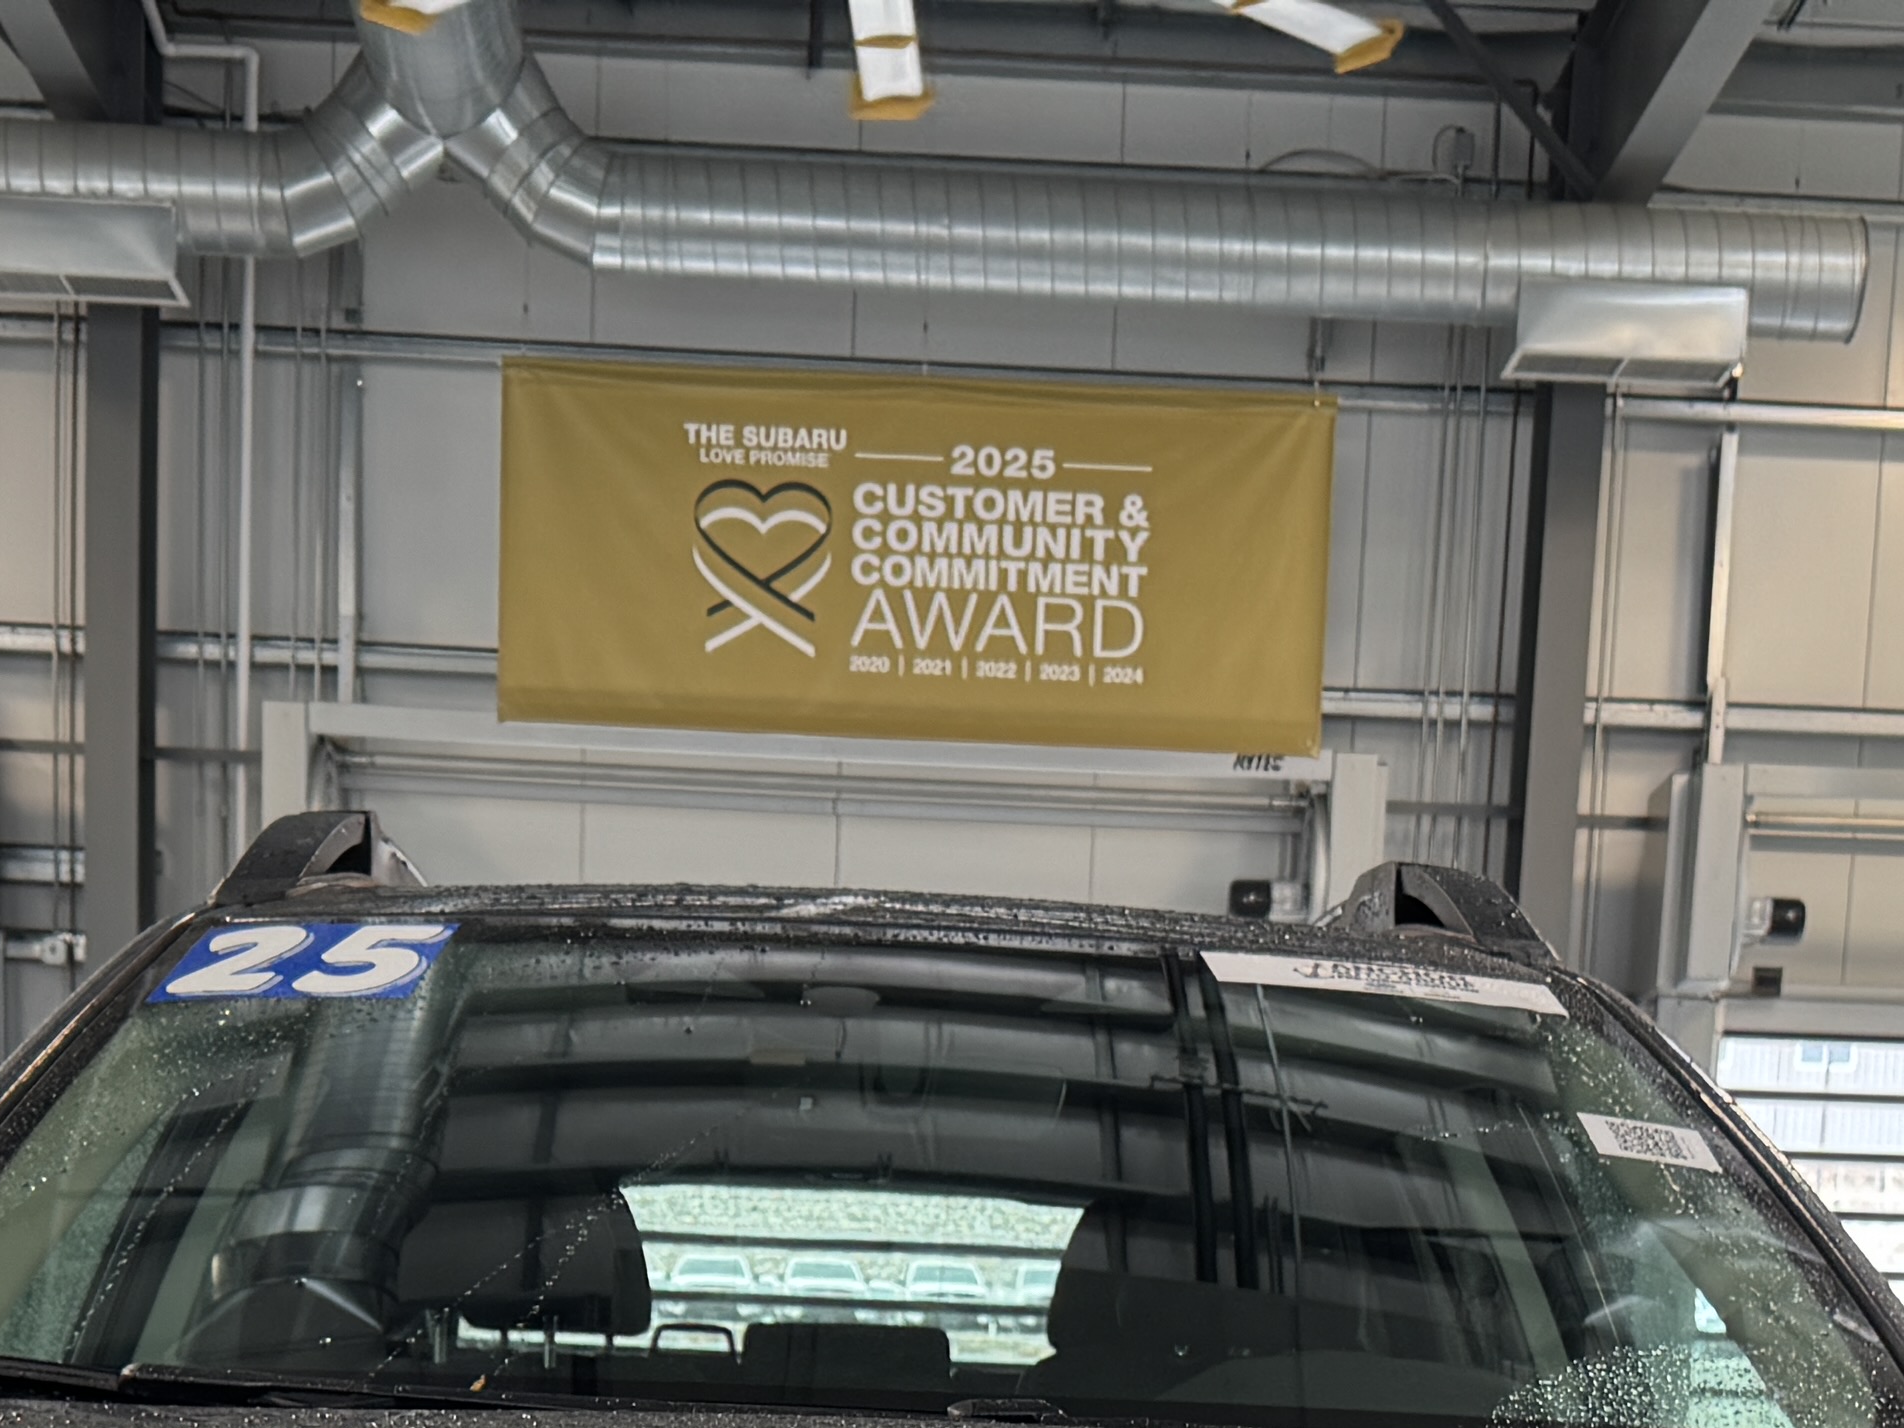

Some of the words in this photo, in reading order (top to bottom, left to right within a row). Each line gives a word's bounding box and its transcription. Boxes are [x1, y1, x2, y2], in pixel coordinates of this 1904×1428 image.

[683, 422, 735, 446] THE
[742, 425, 848, 451] SUBARU
[699, 447, 746, 466] LOVE
[748, 450, 830, 468] PROMISE
[949, 445, 1057, 480] 2025
[852, 482, 1105, 526] CUSTOMER
[1118, 493, 1151, 529] &
[851, 518, 1151, 563] COMMUNITY
[850, 552, 1149, 598] COMMITMENT
[850, 587, 1145, 659] AWARD
[849, 654, 891, 674] 2020
[912, 657, 952, 677] 2021
[975, 659, 1018, 679] 2022
[1039, 662, 1081, 683] 2023
[1103, 665, 1145, 685] 2024
[165, 924, 454, 998] 25
